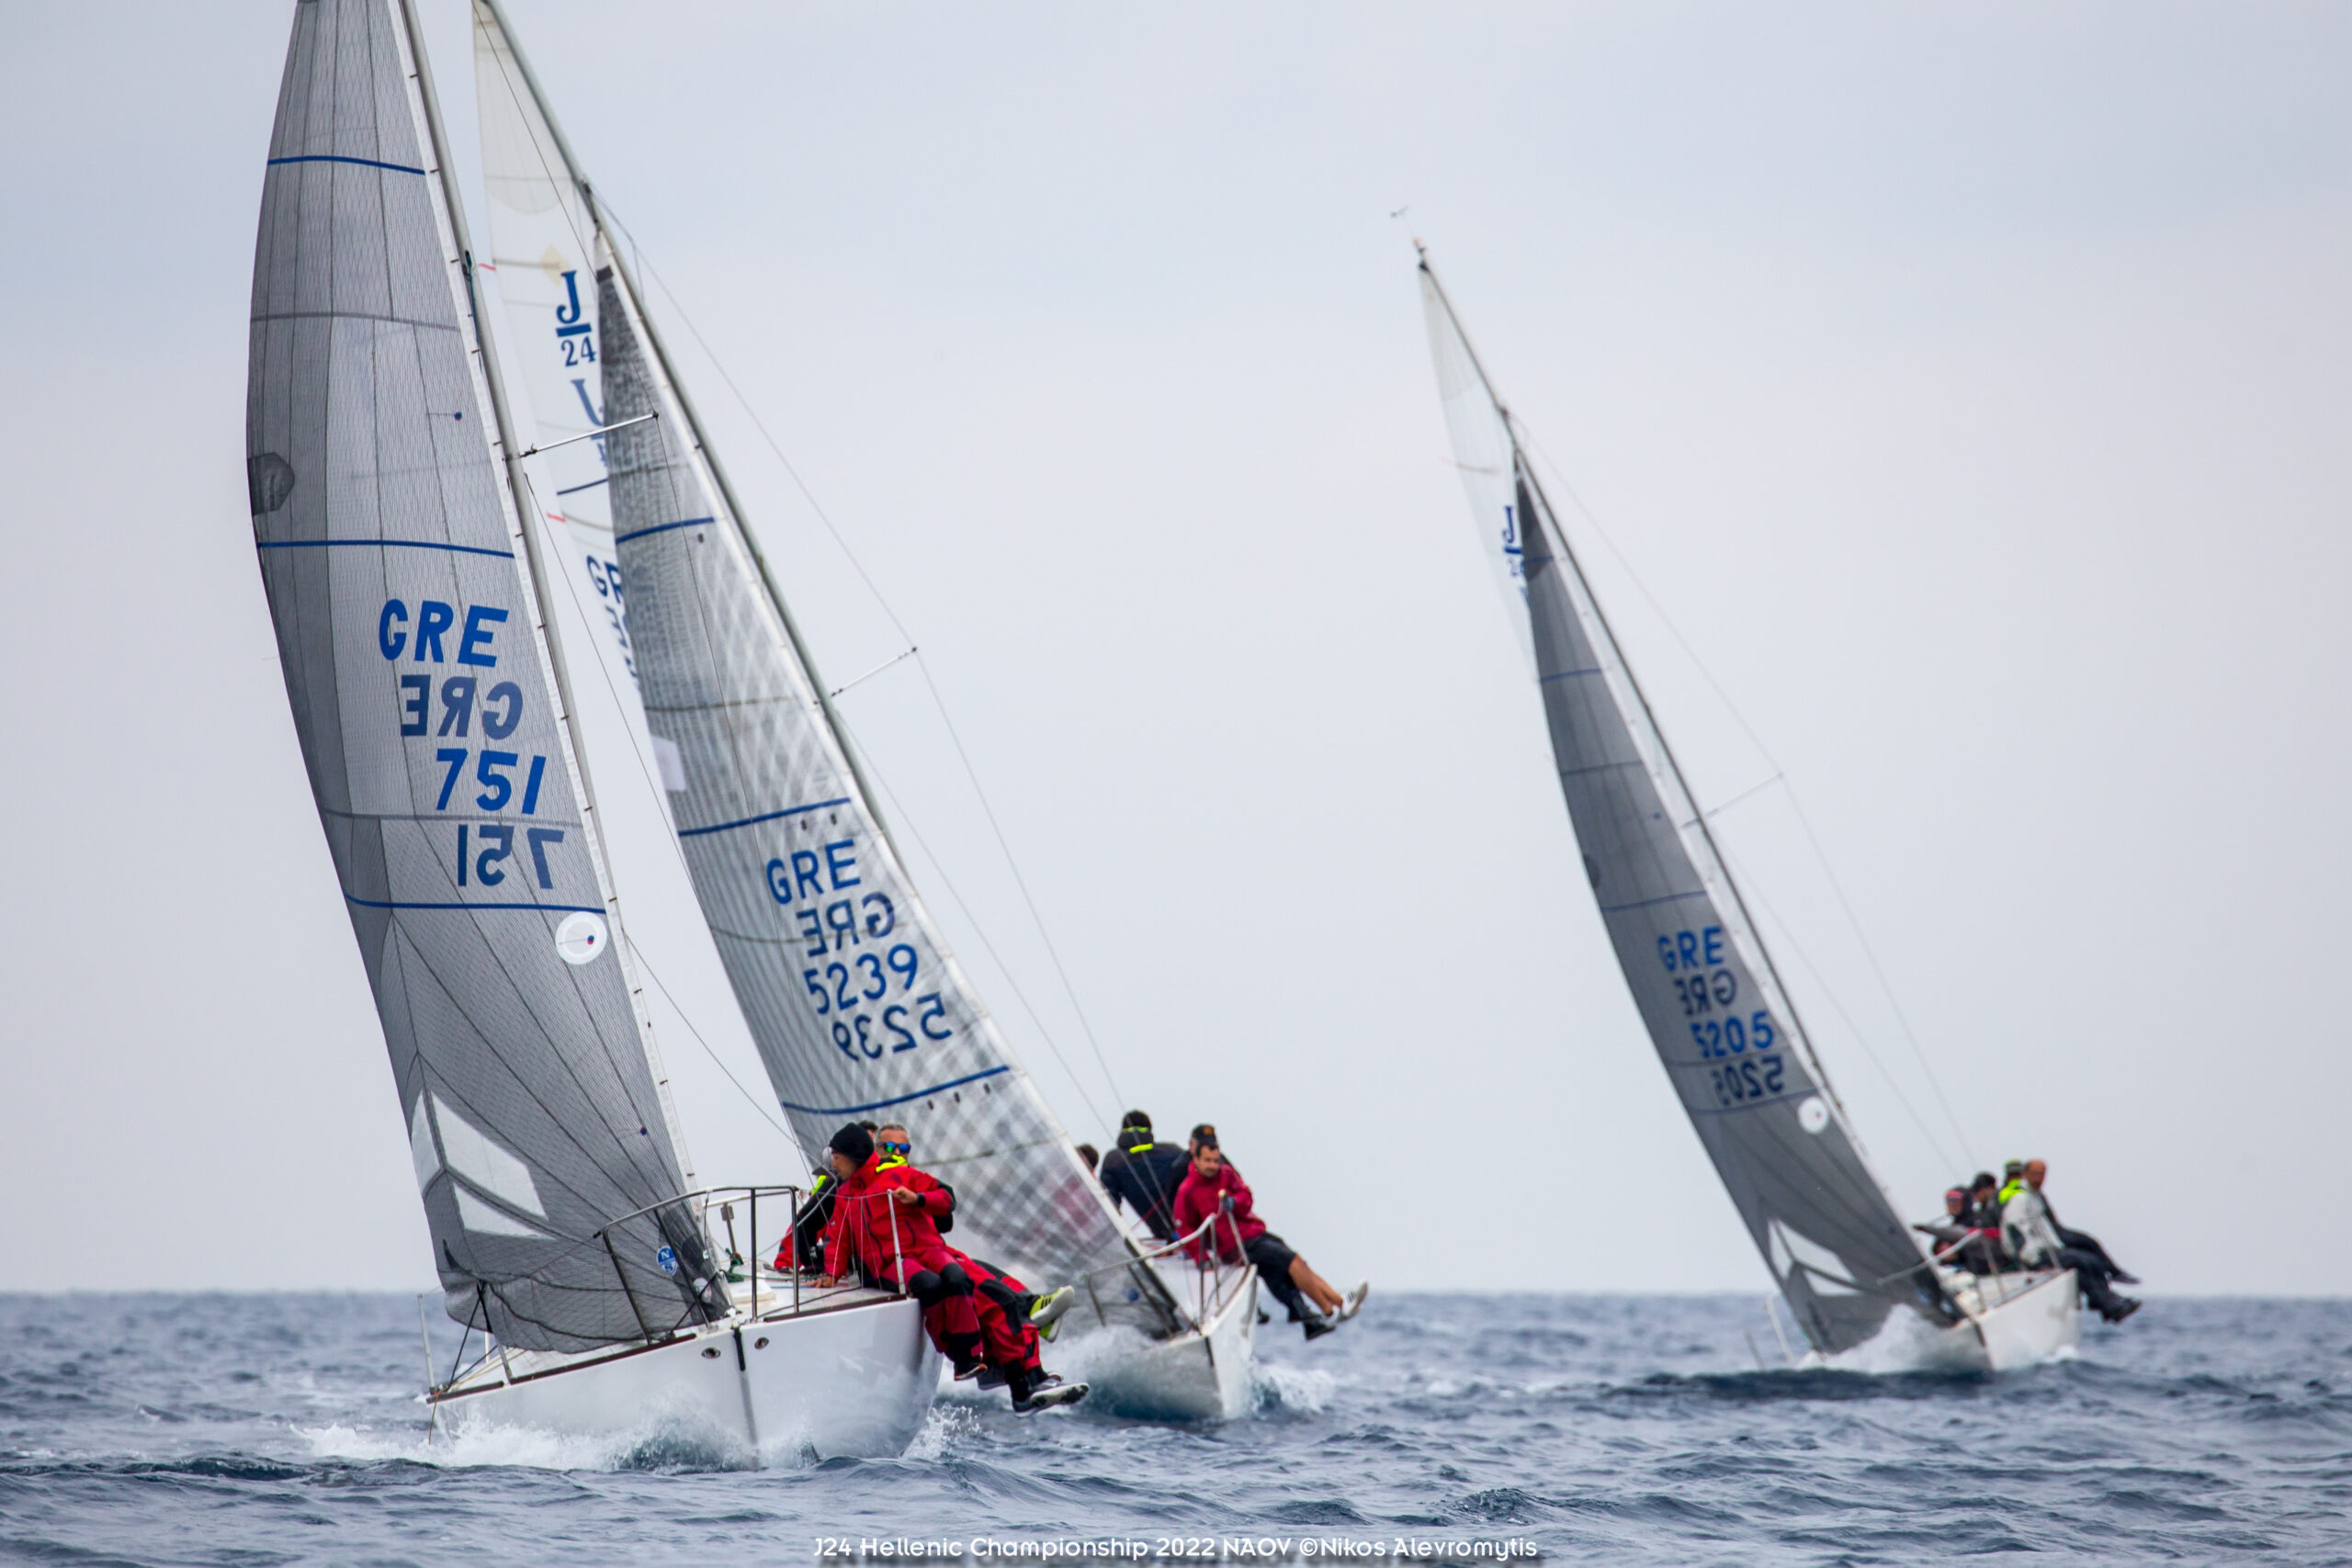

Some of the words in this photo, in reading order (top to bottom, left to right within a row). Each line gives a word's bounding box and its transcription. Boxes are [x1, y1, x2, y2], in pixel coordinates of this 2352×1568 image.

[556, 270, 581, 323] J
[560, 335, 596, 367] 24
[586, 554, 623, 604] GR
[379, 599, 509, 668] GRE
[436, 748, 547, 815] 751
[766, 838, 861, 905] GRE
[1657, 925, 1724, 972] GRE
[803, 943, 918, 1014] 5239
[1690, 1010, 1774, 1058] 5205
